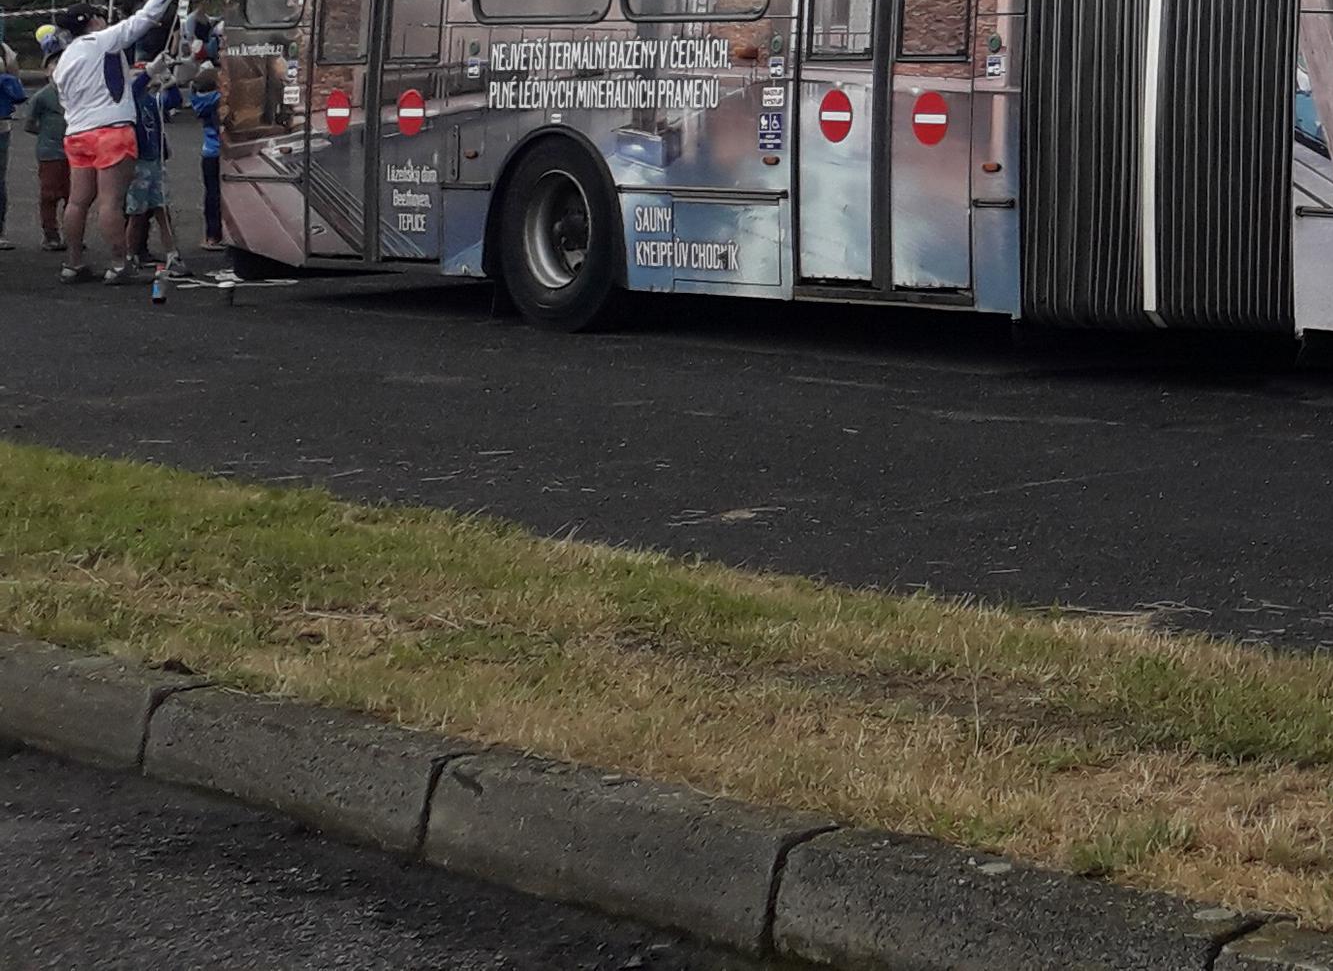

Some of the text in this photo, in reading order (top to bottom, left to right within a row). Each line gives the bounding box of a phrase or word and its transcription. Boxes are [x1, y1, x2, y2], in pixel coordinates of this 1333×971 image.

[490, 35, 732, 71] NEJVĚTŠÍ TERMÁLNÍ BAZÉNY V ČECHÁCH,
[489, 76, 517, 109] PLNÉ
[518, 75, 574, 109] LÉČIVÝCH
[575, 75, 656, 109] MINERÁLNÍCH
